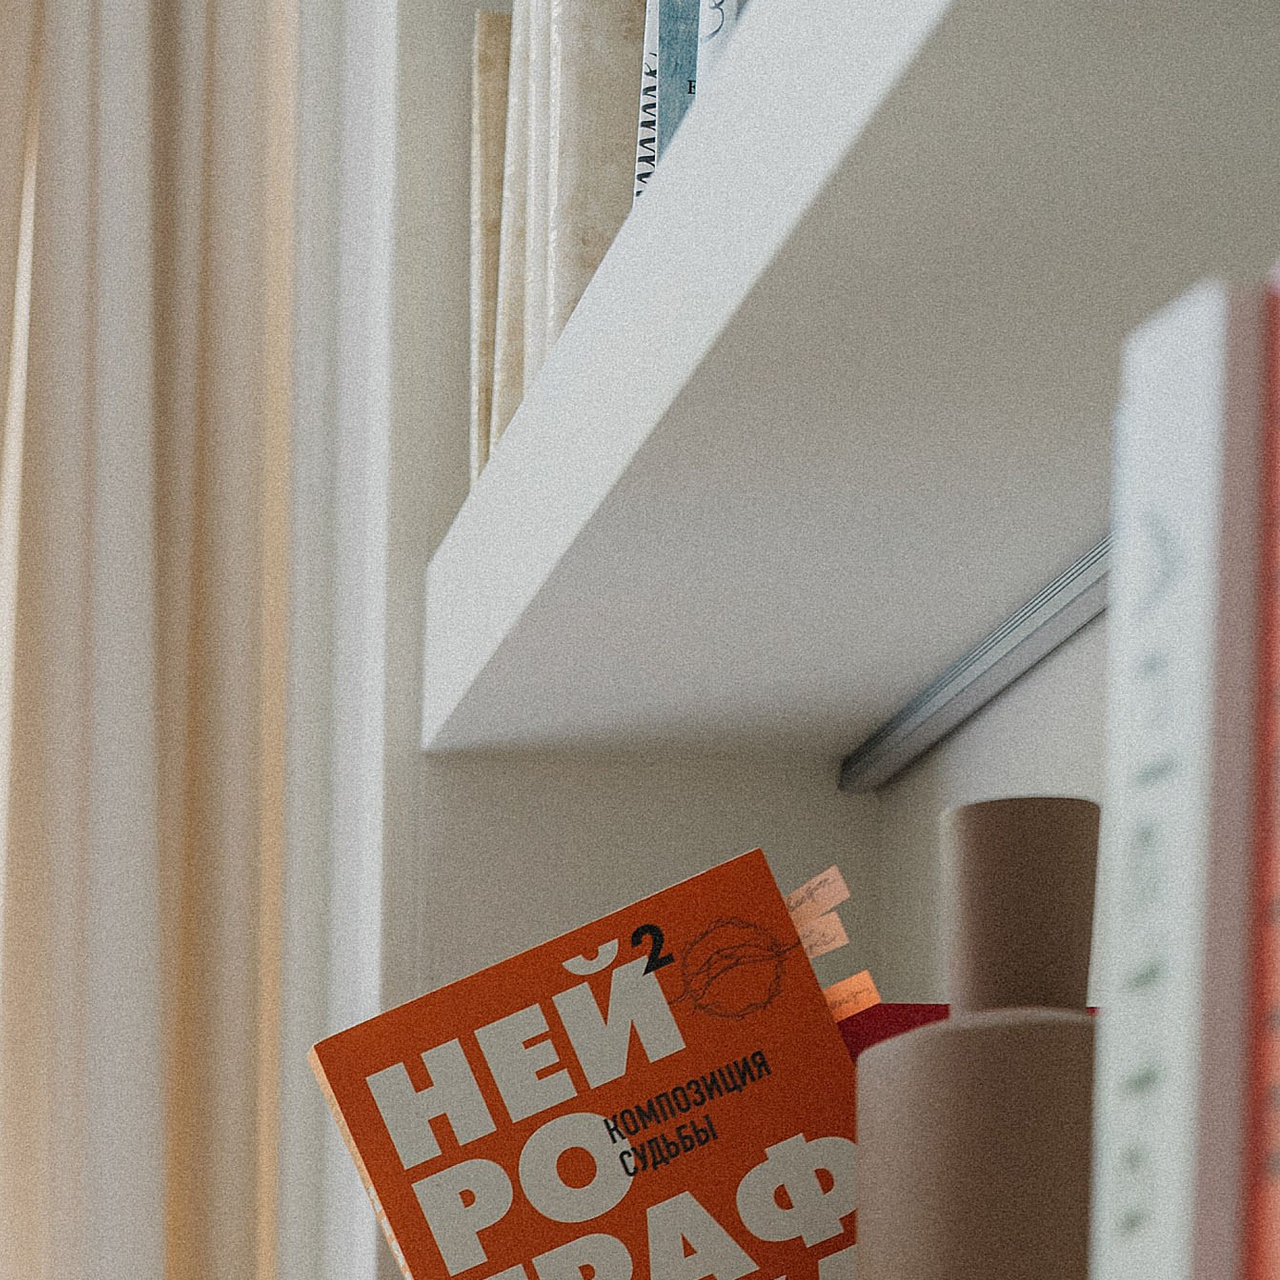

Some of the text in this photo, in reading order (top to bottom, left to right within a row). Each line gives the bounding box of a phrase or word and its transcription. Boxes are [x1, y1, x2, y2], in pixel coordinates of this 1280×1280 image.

[631, 923, 675, 977] 2
[365, 938, 687, 1171] НЕЙ
[603, 1050, 772, 1145] КОМПОЗИЦИЯ
[620, 1113, 719, 1178] СУДЬБЫ
[411, 1112, 635, 1277] РО
